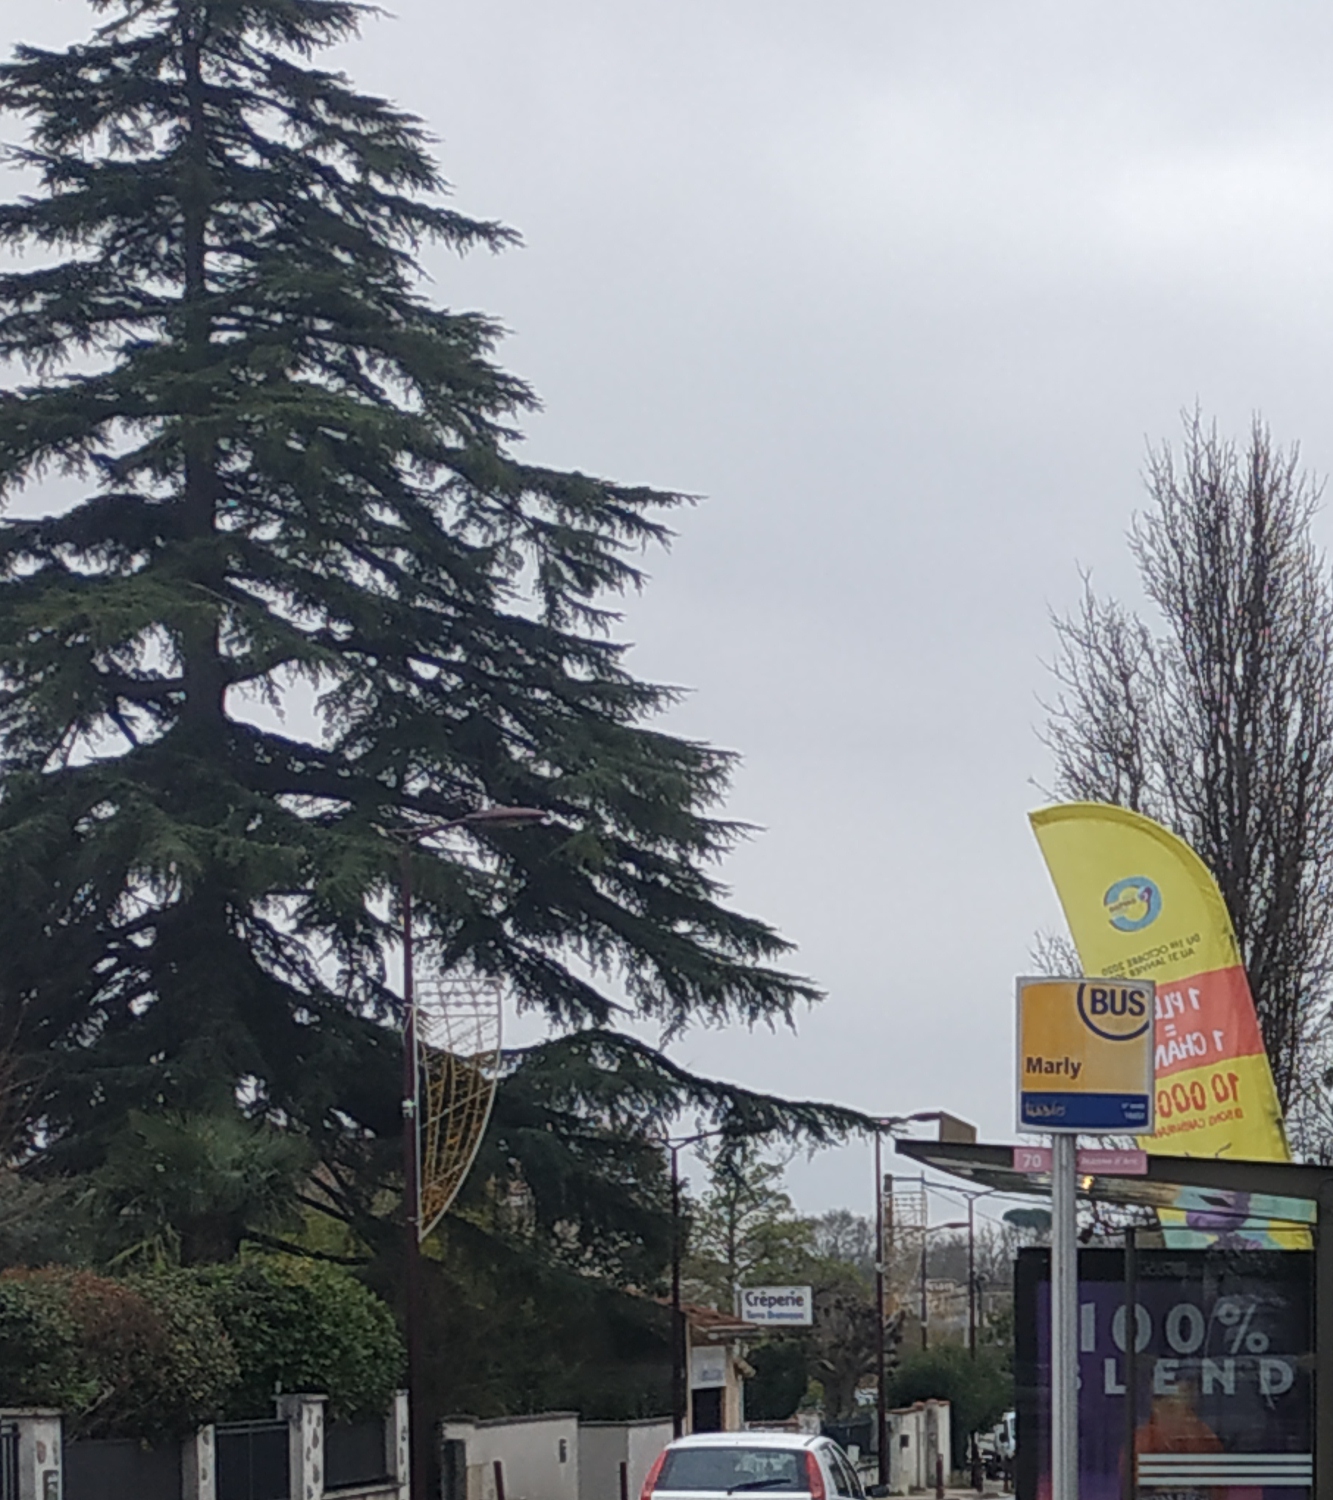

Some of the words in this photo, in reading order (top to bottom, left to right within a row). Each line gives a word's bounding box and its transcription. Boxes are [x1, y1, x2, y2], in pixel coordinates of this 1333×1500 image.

[1090, 988, 1146, 1016] BUS
[1025, 1056, 1082, 1079] Marly
[1022, 1154, 1042, 1168] 70
[745, 1290, 804, 1308] Crêperie
[1080, 1302, 1271, 1355] 100%
